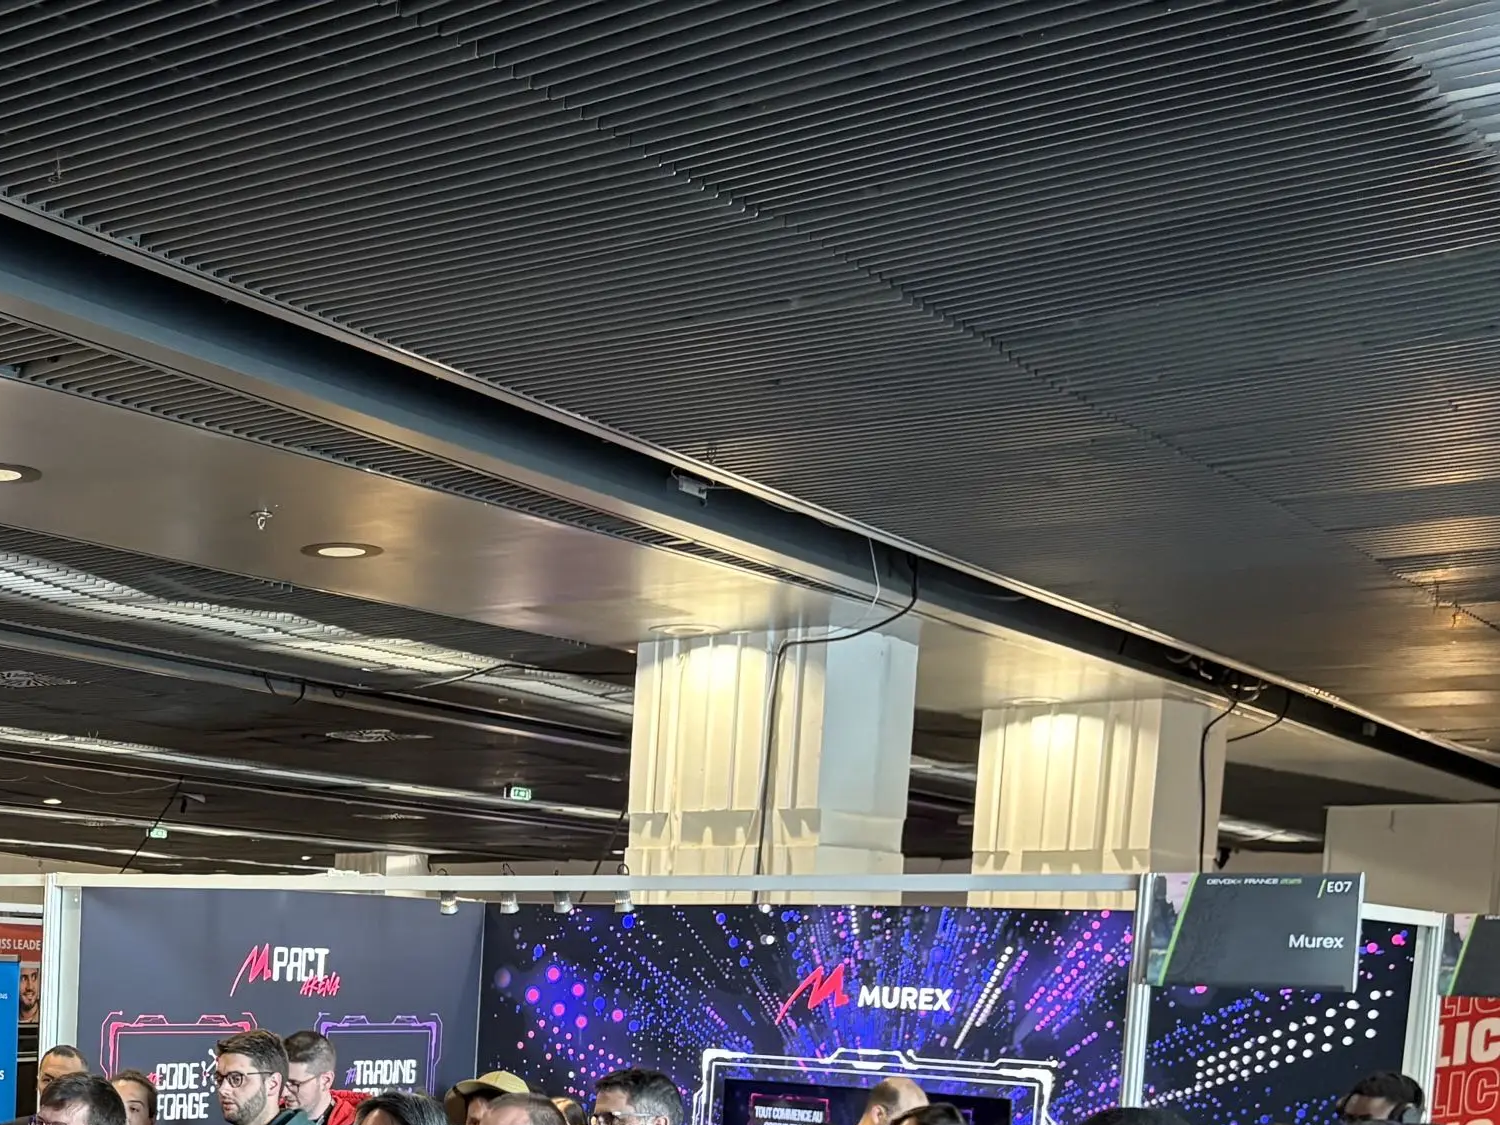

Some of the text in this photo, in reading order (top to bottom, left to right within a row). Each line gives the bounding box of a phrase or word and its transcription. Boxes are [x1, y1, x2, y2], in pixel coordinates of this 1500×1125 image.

[13, 941, 41, 951] LEADE
[1289, 934, 1343, 948] Murex
[229, 943, 330, 997] MPACT
[300, 972, 341, 997] ARENA
[858, 985, 953, 1012] MUREX
[156, 1092, 210, 1121] FORGE
[755, 1105, 823, 1122] TOUT COMMENCE AU
